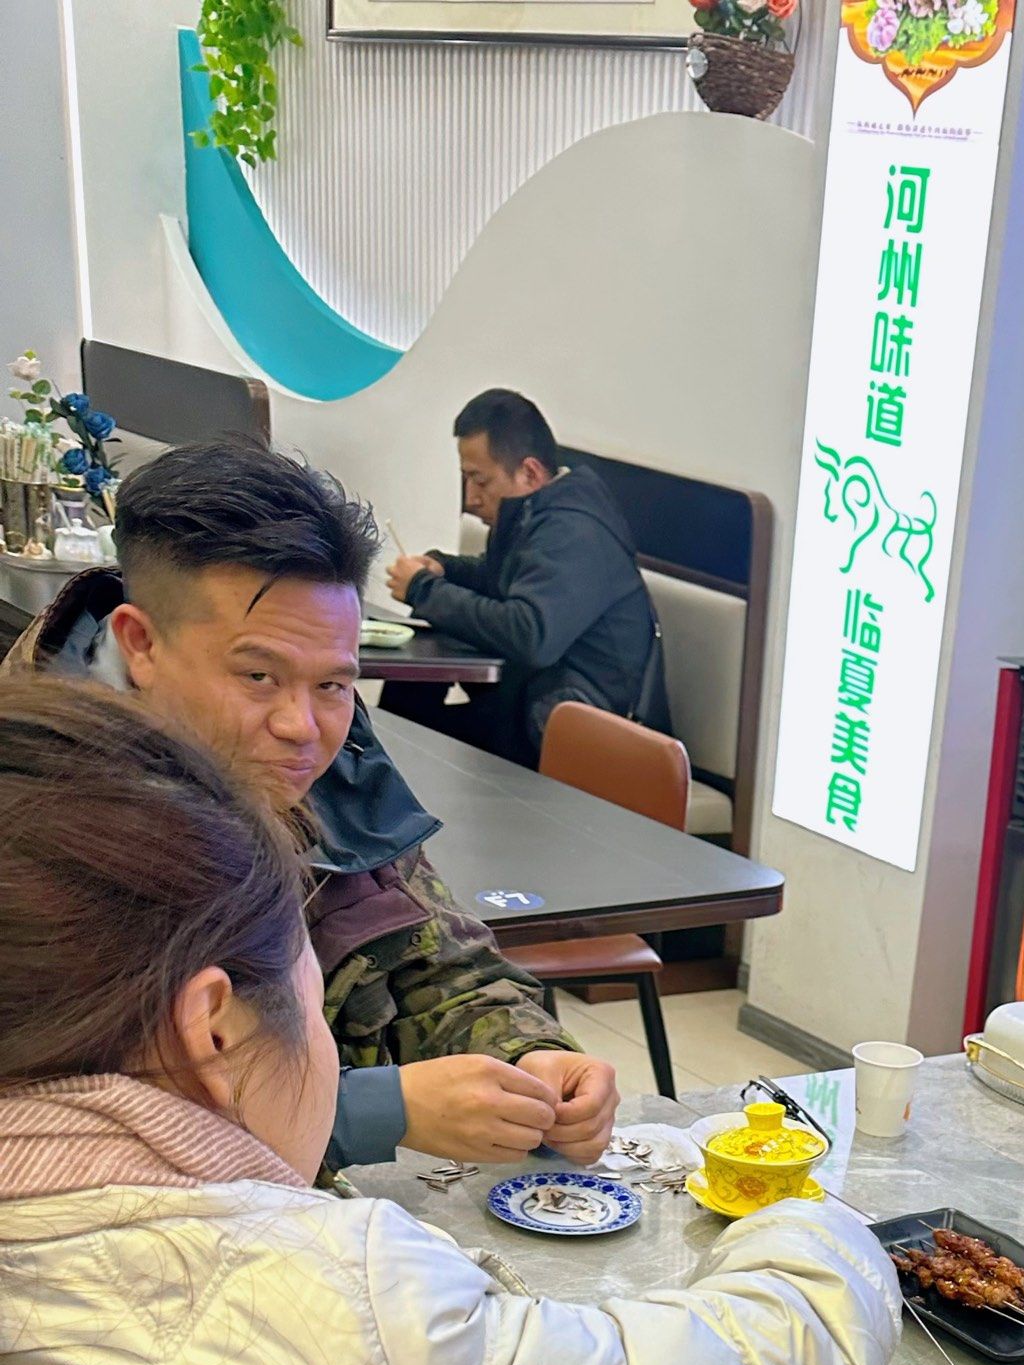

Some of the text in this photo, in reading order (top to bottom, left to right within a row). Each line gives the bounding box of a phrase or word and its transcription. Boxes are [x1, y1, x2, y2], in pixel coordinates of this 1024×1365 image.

[866, 165, 931, 447] 河州味道
[826, 588, 884, 832] 临夏美食
